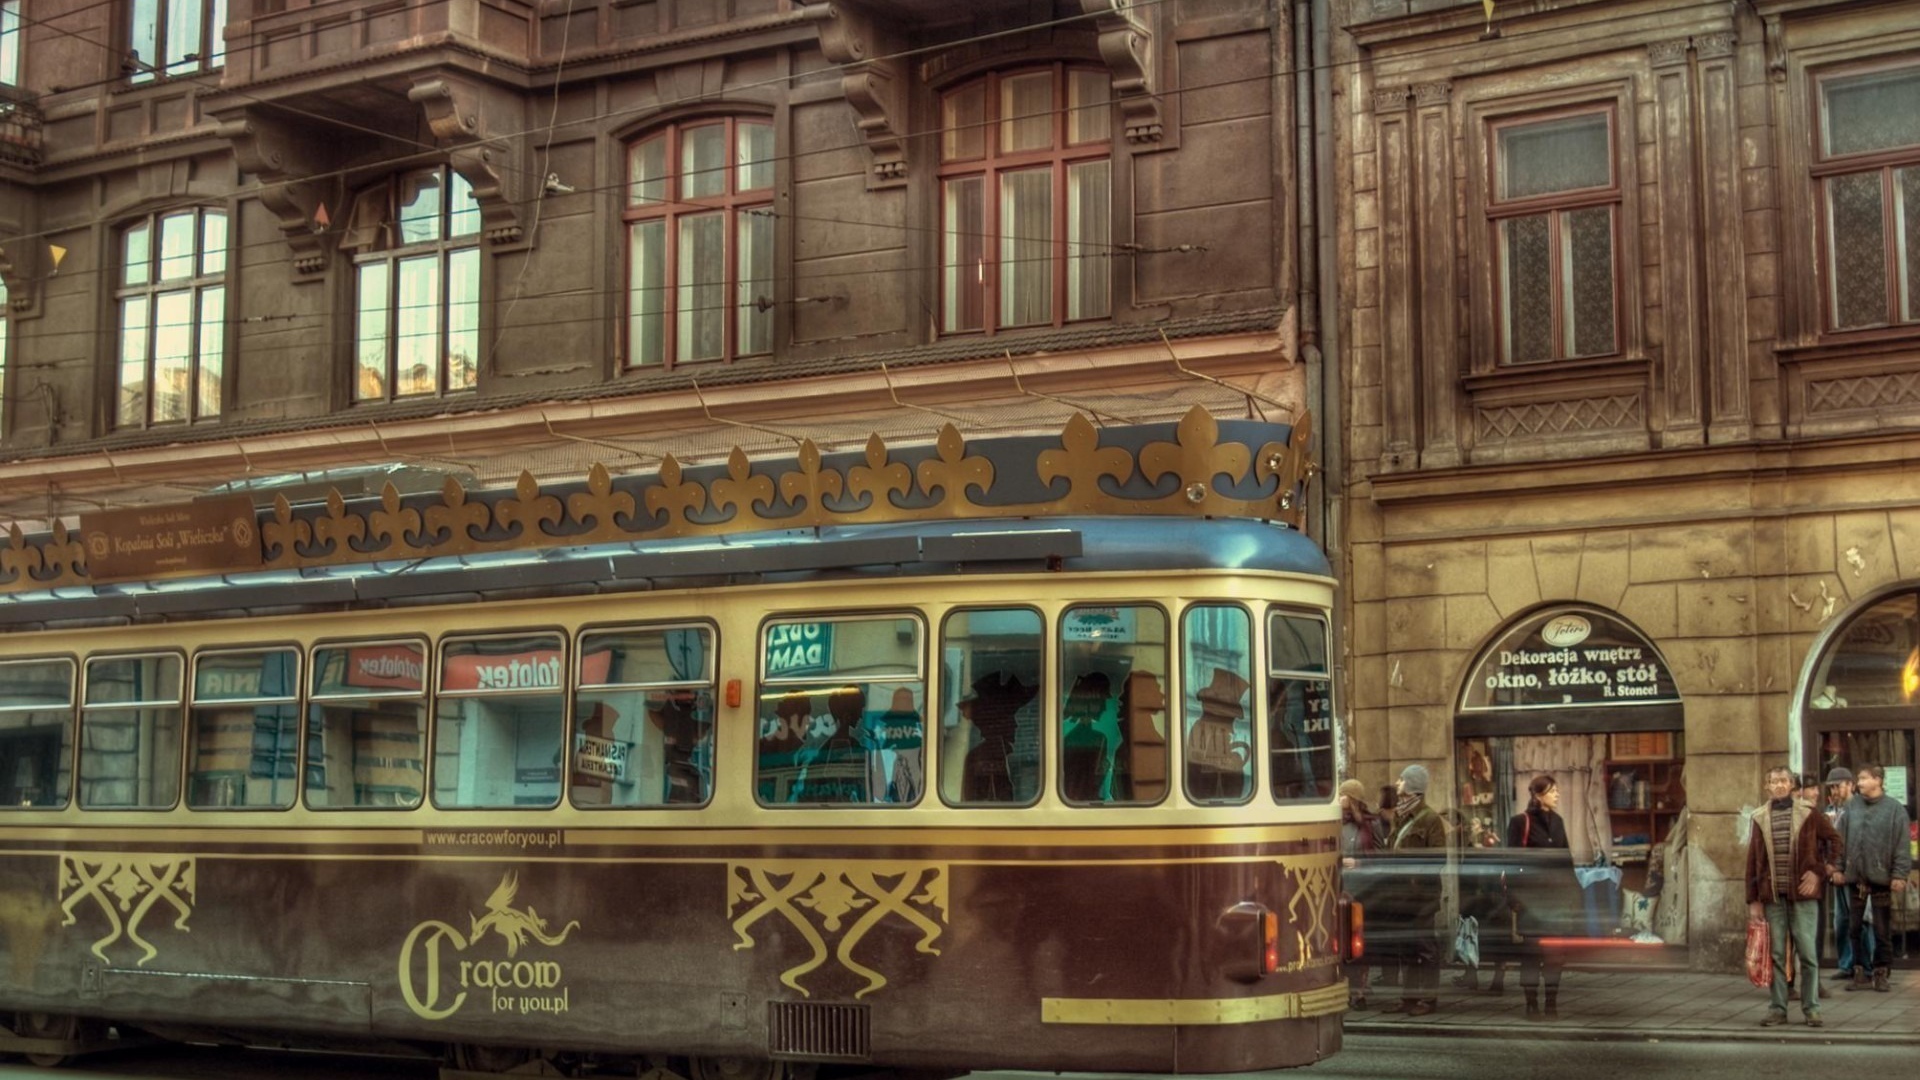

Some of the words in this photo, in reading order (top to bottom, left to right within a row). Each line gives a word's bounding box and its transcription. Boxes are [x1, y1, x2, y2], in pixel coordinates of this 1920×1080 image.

[114, 534, 154, 556] Kopalnia
[155, 531, 174, 549] Soli
[1500, 648, 1578, 666] Dekoracja
[1584, 646, 1641, 664] wnętrz
[1486, 672, 1542, 689] okno,
[1548, 665, 1612, 686] łóżko,
[1616, 663, 1659, 682] stół
[1603, 686, 1616, 697] R.
[1617, 684, 1658, 697] Stoncel
[427, 829, 561, 848] www.cracowforyou.pl
[398, 919, 562, 1021] Cracow
[491, 986, 514, 1013] for
[519, 986, 569, 1015] you.pl
